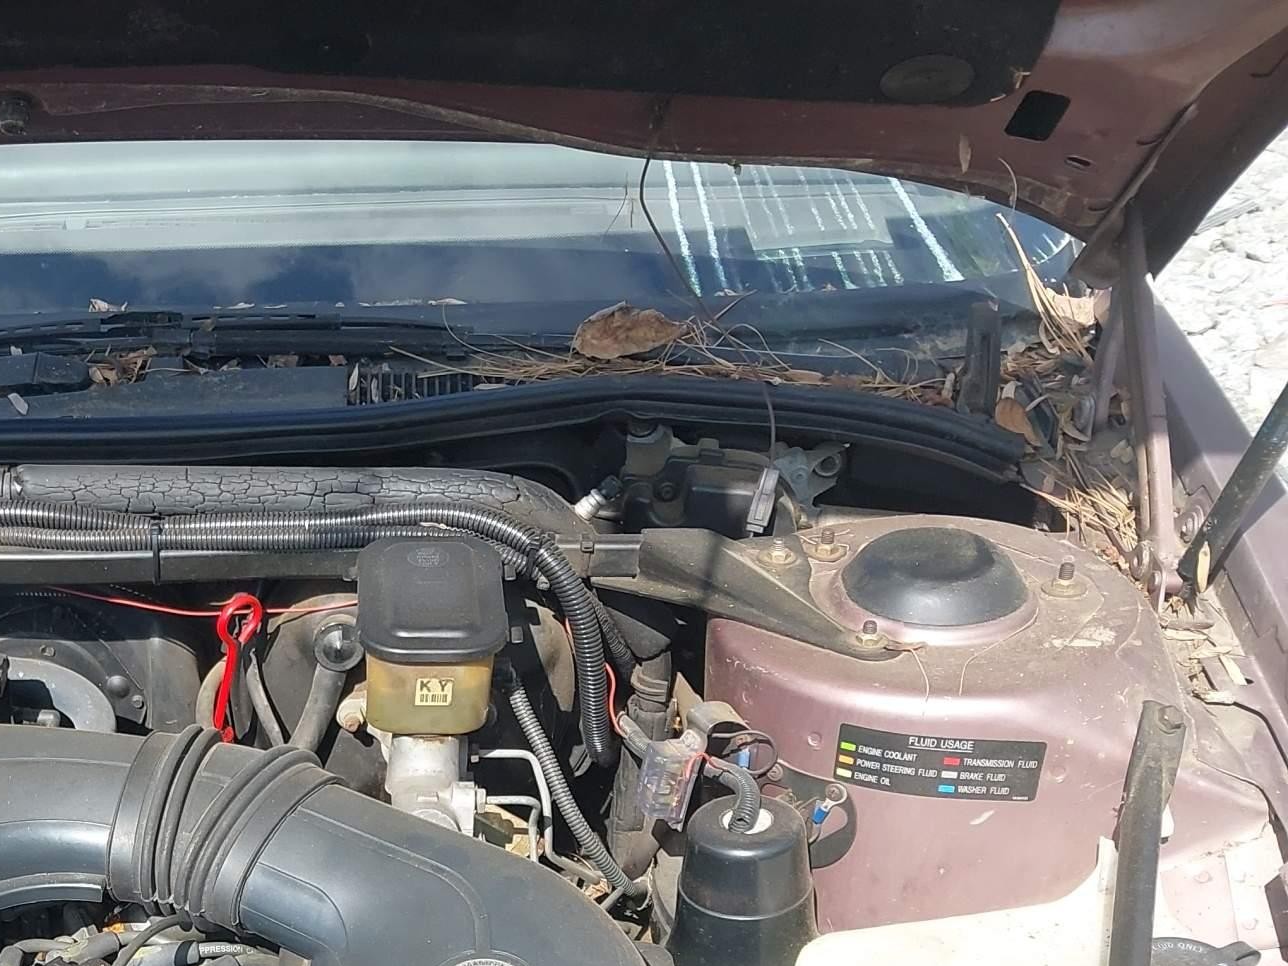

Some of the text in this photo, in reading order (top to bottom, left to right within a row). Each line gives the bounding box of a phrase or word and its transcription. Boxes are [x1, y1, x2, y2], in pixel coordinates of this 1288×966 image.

[909, 737, 974, 750] FLUID USAGE
[858, 746, 917, 761] ENGINE COOLANT
[857, 759, 937, 777] POWER STEERING FLUID
[963, 758, 1038, 768] TRANSMISSION FLUID
[854, 772, 891, 786] ENGINE OIL
[960, 772, 1005, 782] BRAKE FLUID
[958, 786, 1009, 795] WASHER FLUID
